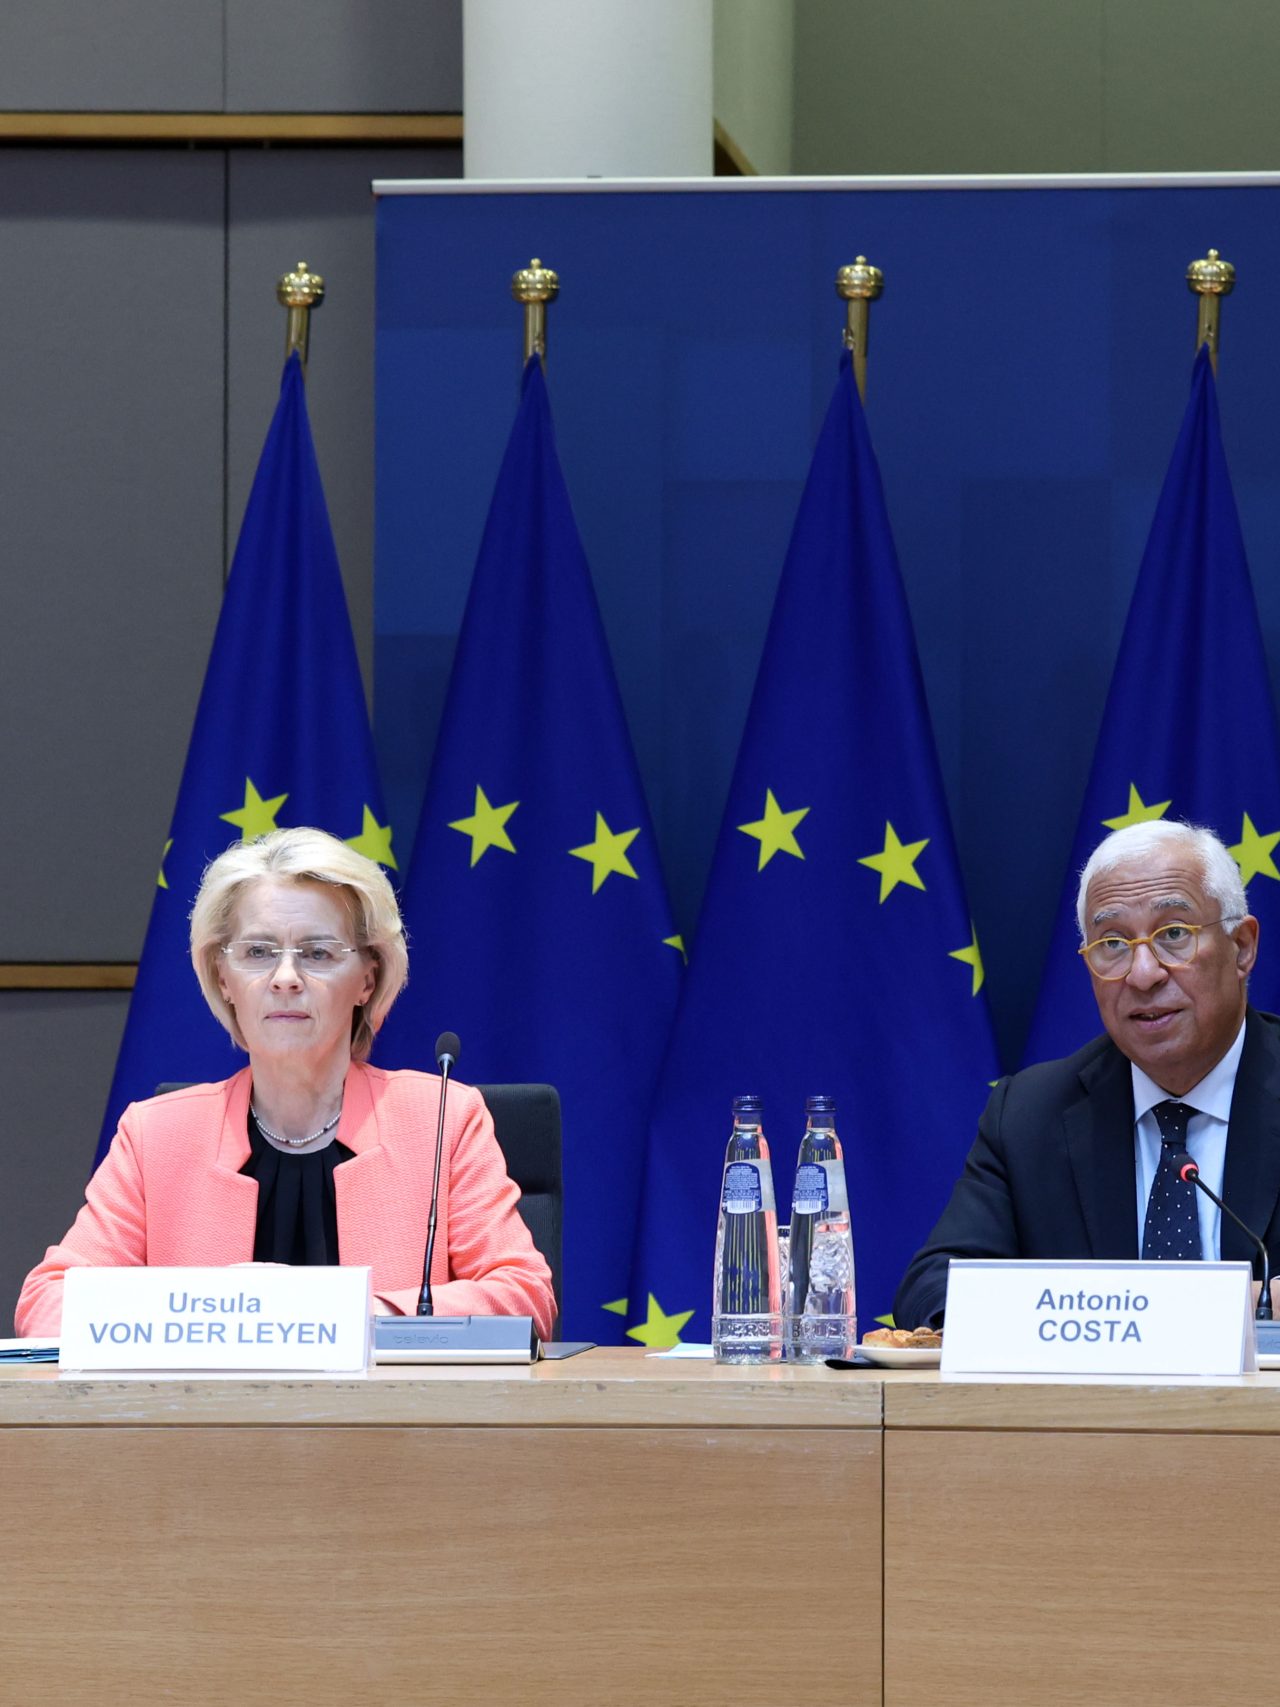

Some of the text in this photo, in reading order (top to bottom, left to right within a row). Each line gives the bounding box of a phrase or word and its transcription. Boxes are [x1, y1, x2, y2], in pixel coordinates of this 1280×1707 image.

[168, 1291, 261, 1314] Ursula
[1035, 1288, 1150, 1312] Antonio
[88, 1321, 337, 1345] VON DER LEYEN
[1038, 1319, 1142, 1343] COSTA
